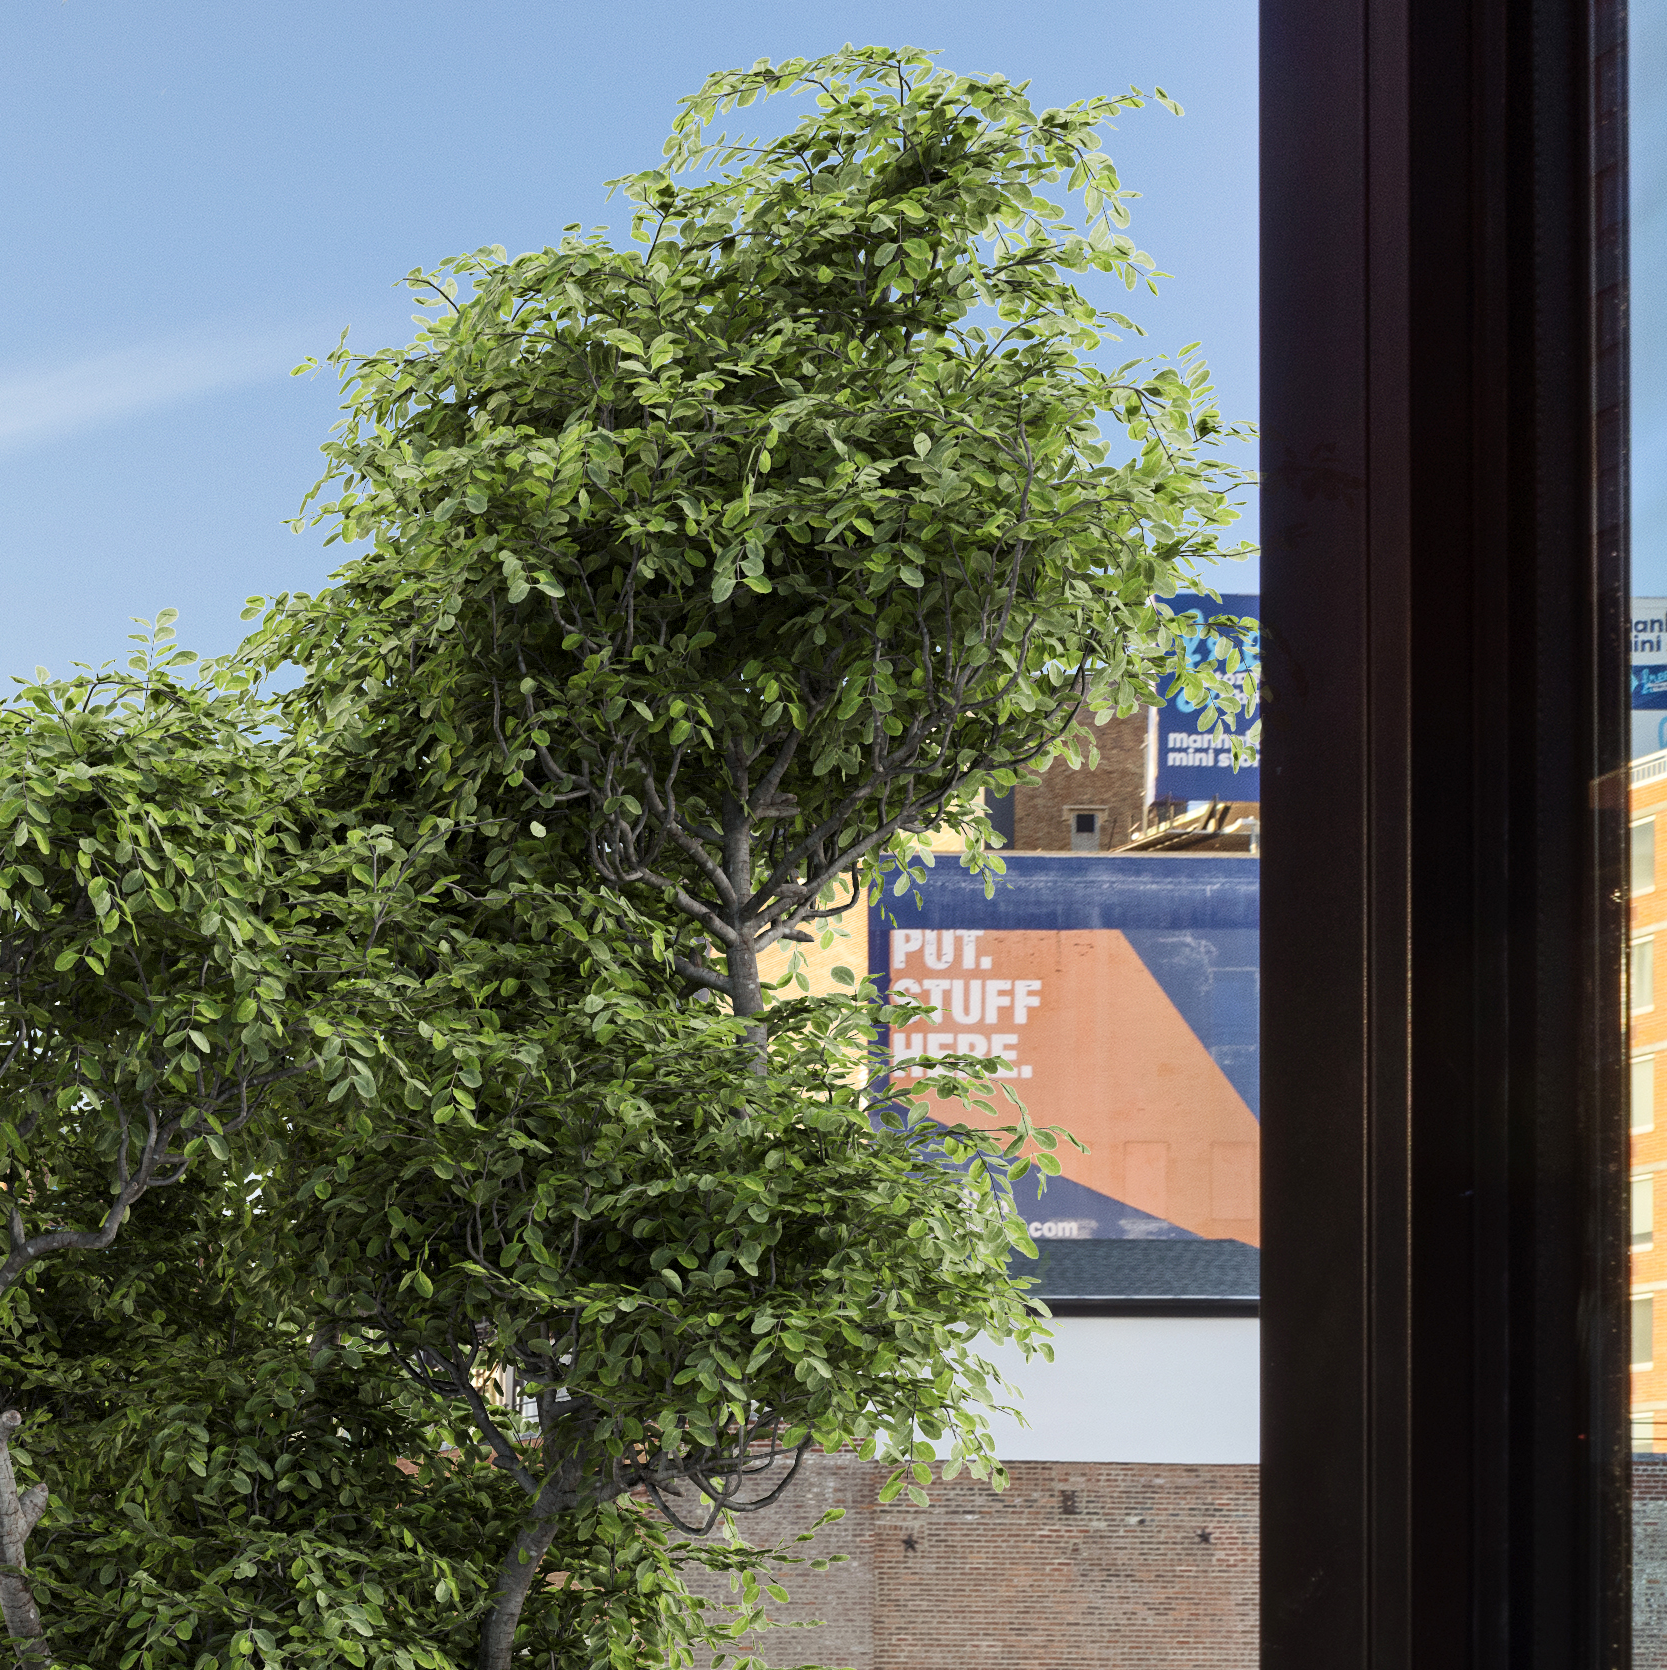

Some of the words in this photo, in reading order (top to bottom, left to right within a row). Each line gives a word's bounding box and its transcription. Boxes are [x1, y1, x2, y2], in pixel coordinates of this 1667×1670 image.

[1168, 749, 1214, 766] mini
[893, 929, 992, 970] PUT.
[892, 978, 1042, 1024] STUFF
